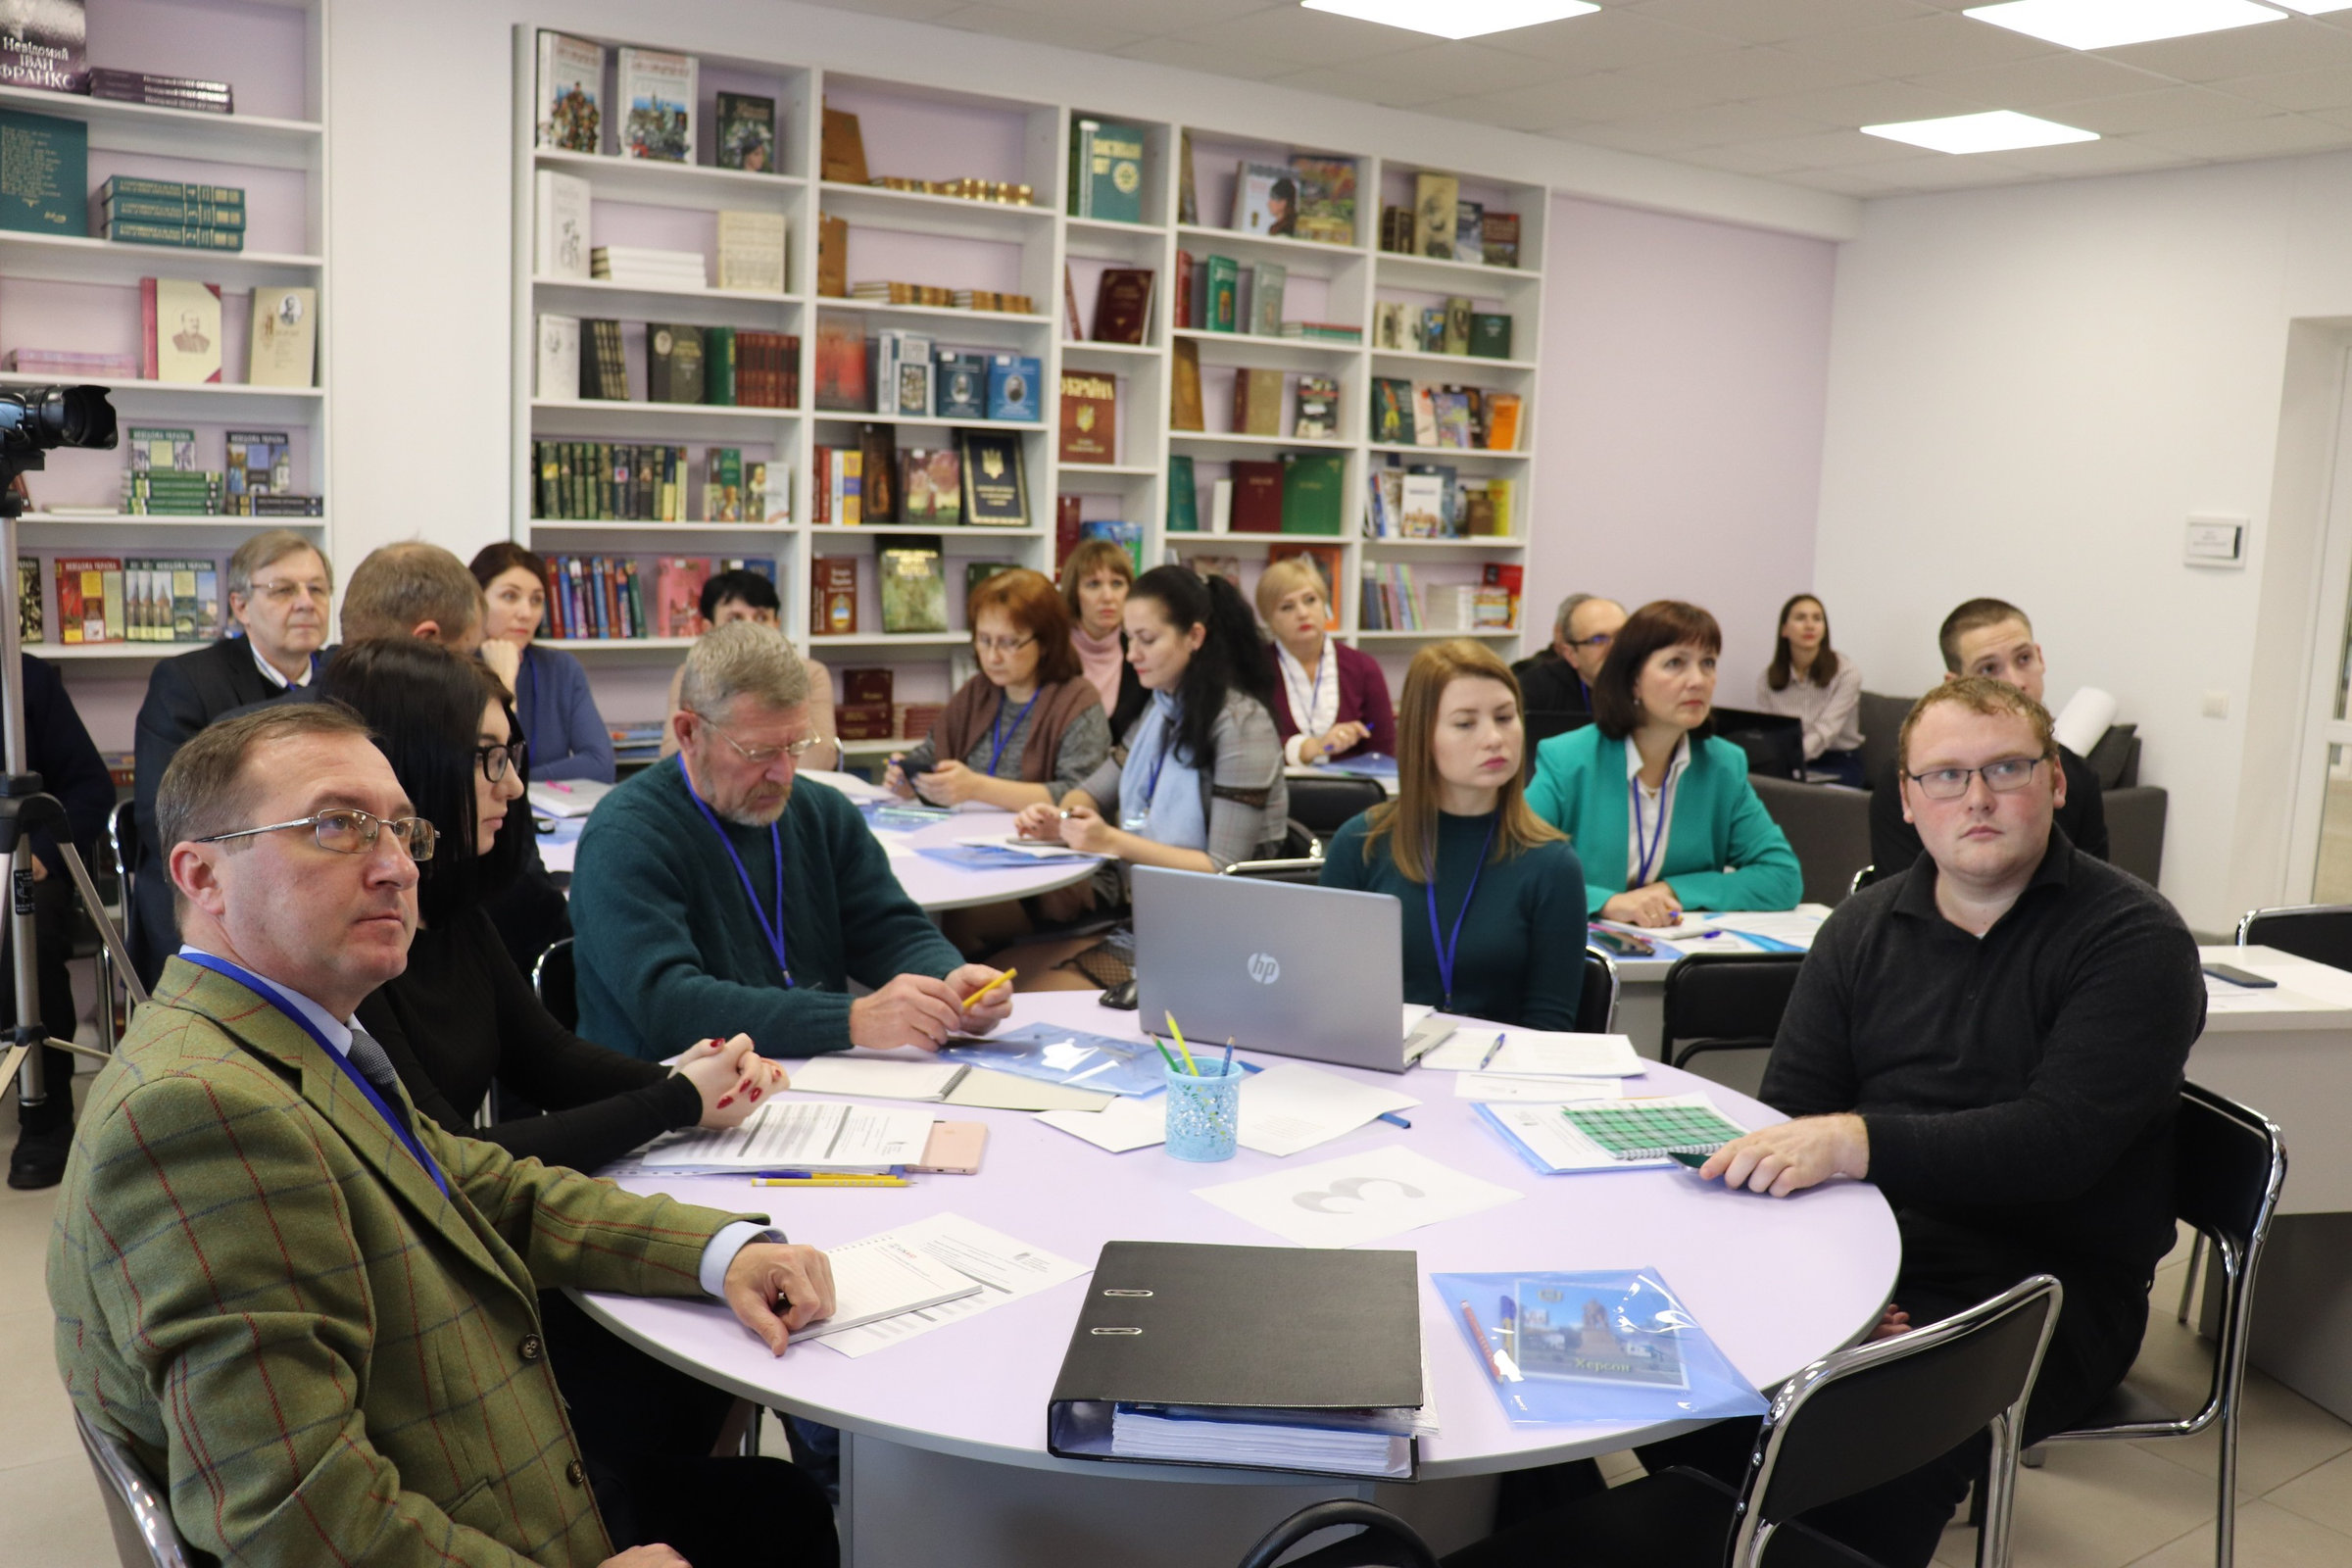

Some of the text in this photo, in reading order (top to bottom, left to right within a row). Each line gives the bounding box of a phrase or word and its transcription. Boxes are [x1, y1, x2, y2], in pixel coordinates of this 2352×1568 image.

[3, 36, 70, 61] Невідомий
[21, 54, 53, 72] ІВАН
[0, 63, 75, 90] ФРАНКО
[1250, 953, 1278, 984] hp
[1575, 1356, 1632, 1372] Херсон
